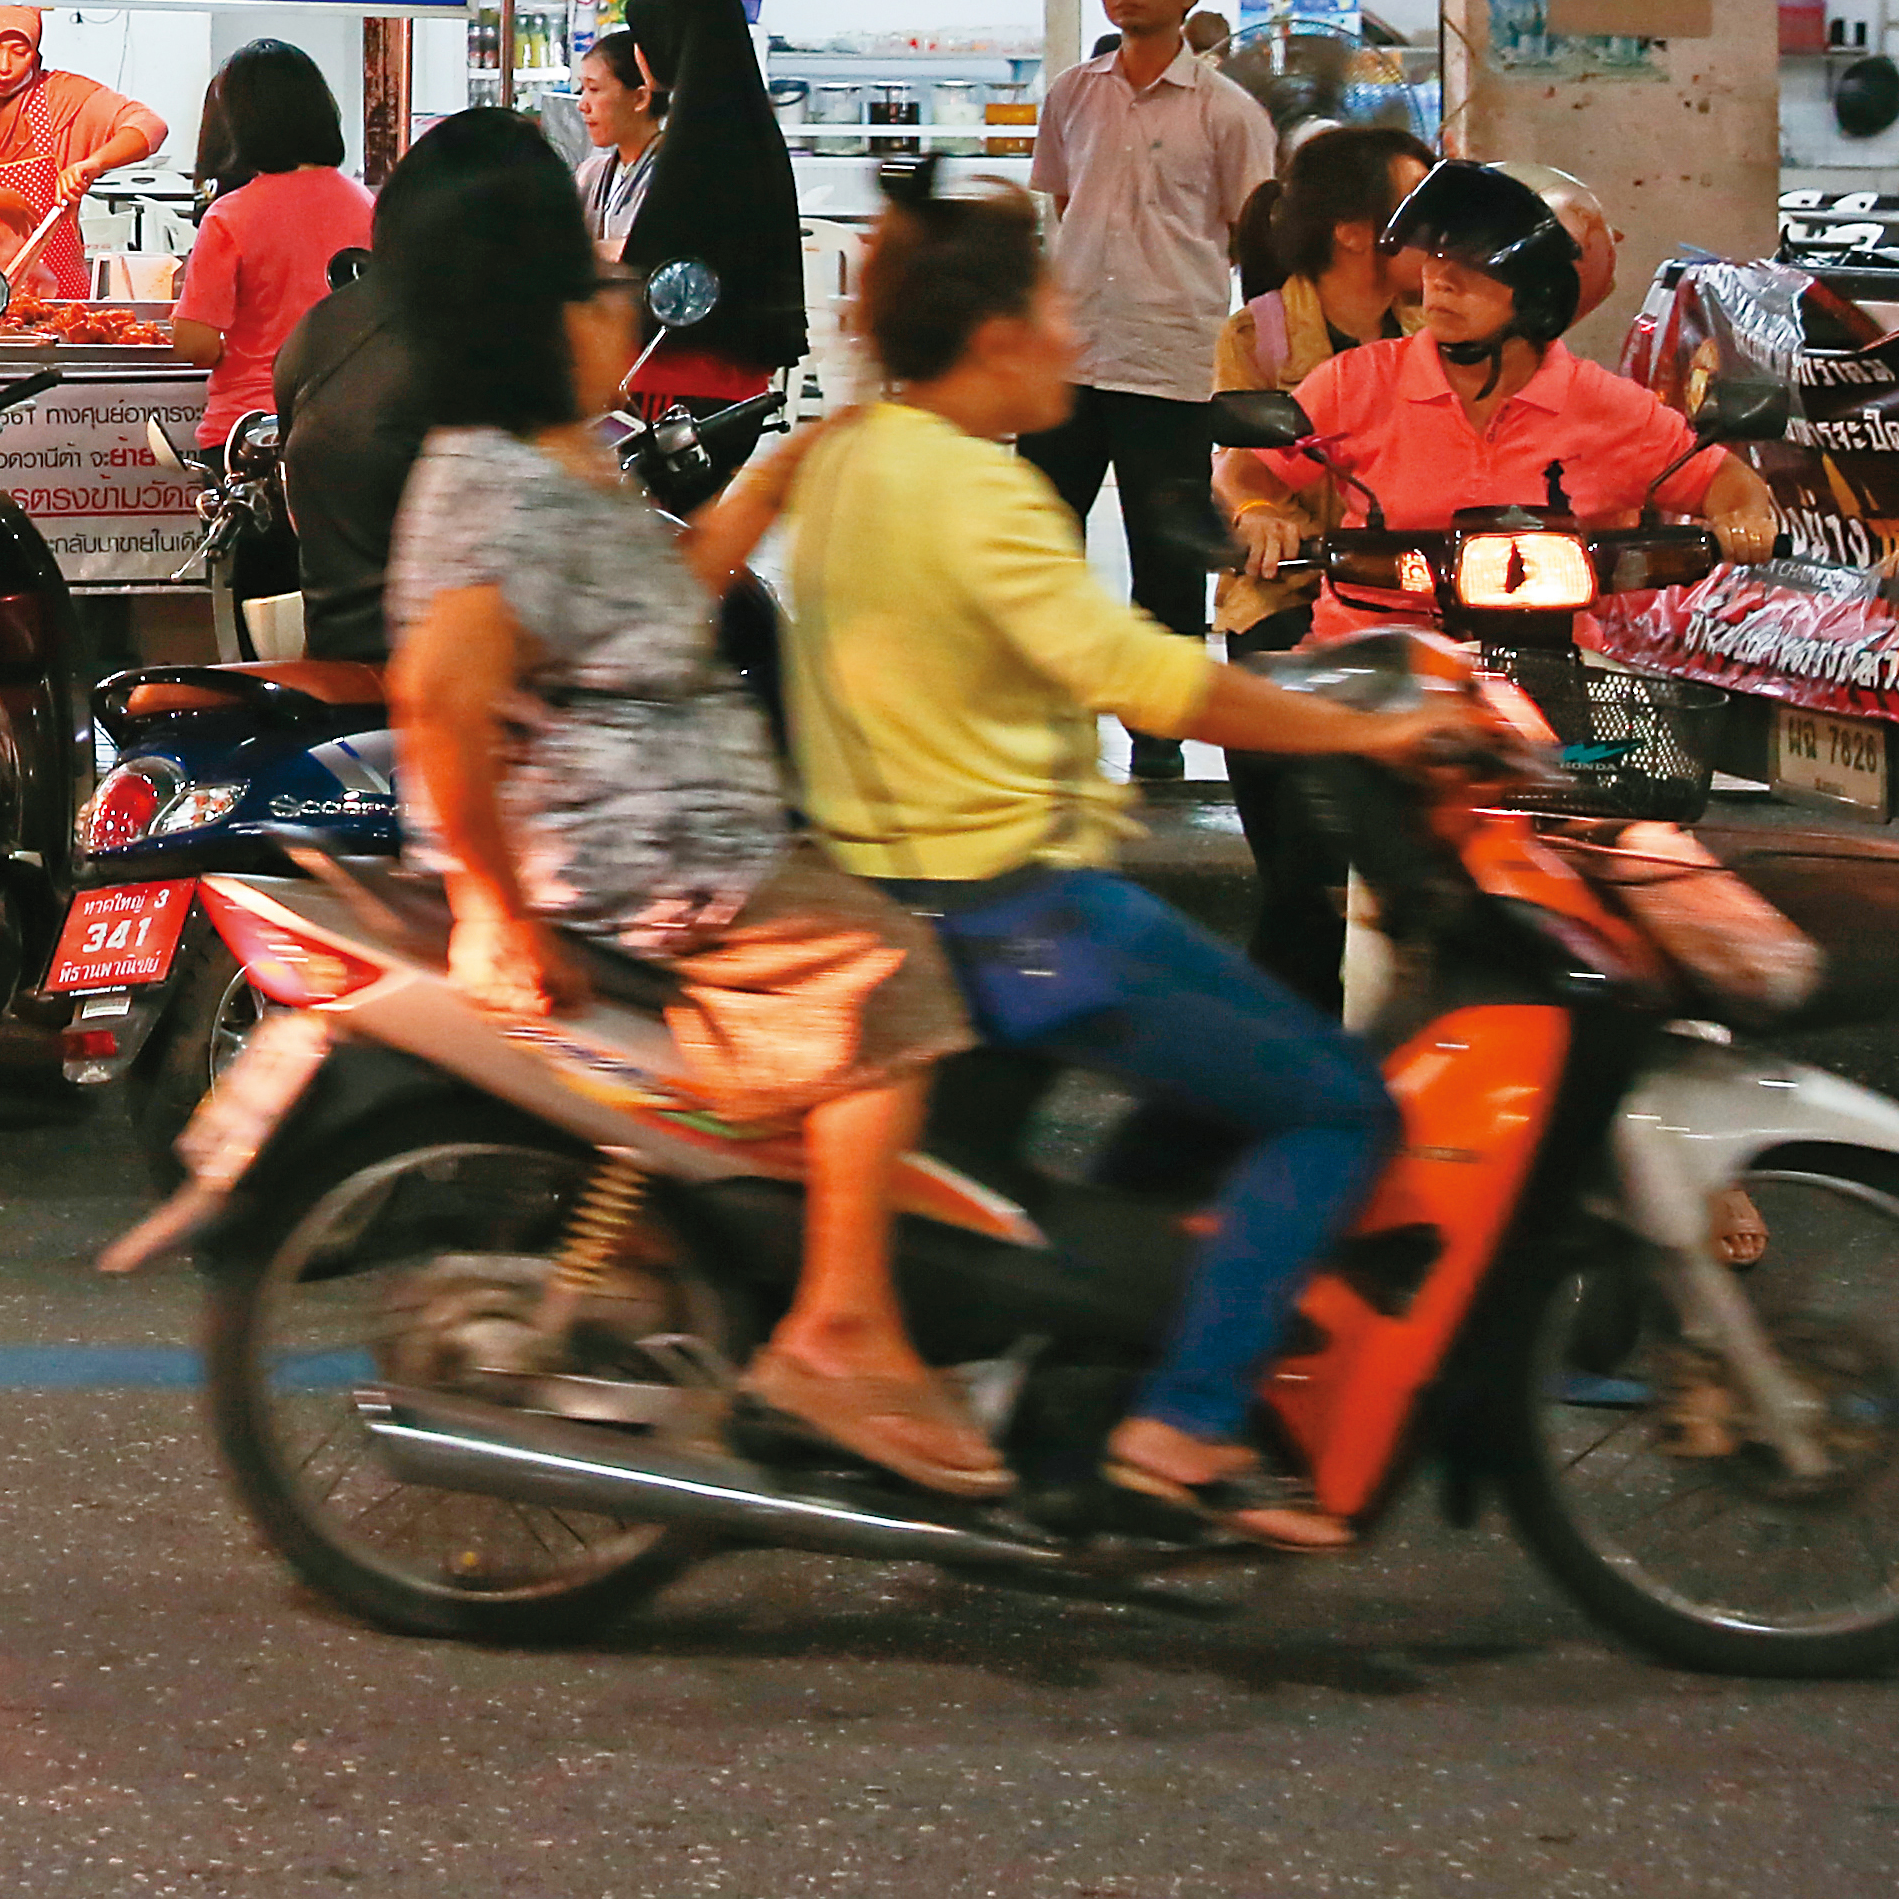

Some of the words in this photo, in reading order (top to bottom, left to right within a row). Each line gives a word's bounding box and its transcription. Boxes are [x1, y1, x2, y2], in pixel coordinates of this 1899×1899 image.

[83, 889, 148, 916] หาดใหญ่
[154, 888, 170, 909] 3
[81, 916, 154, 954] 341
